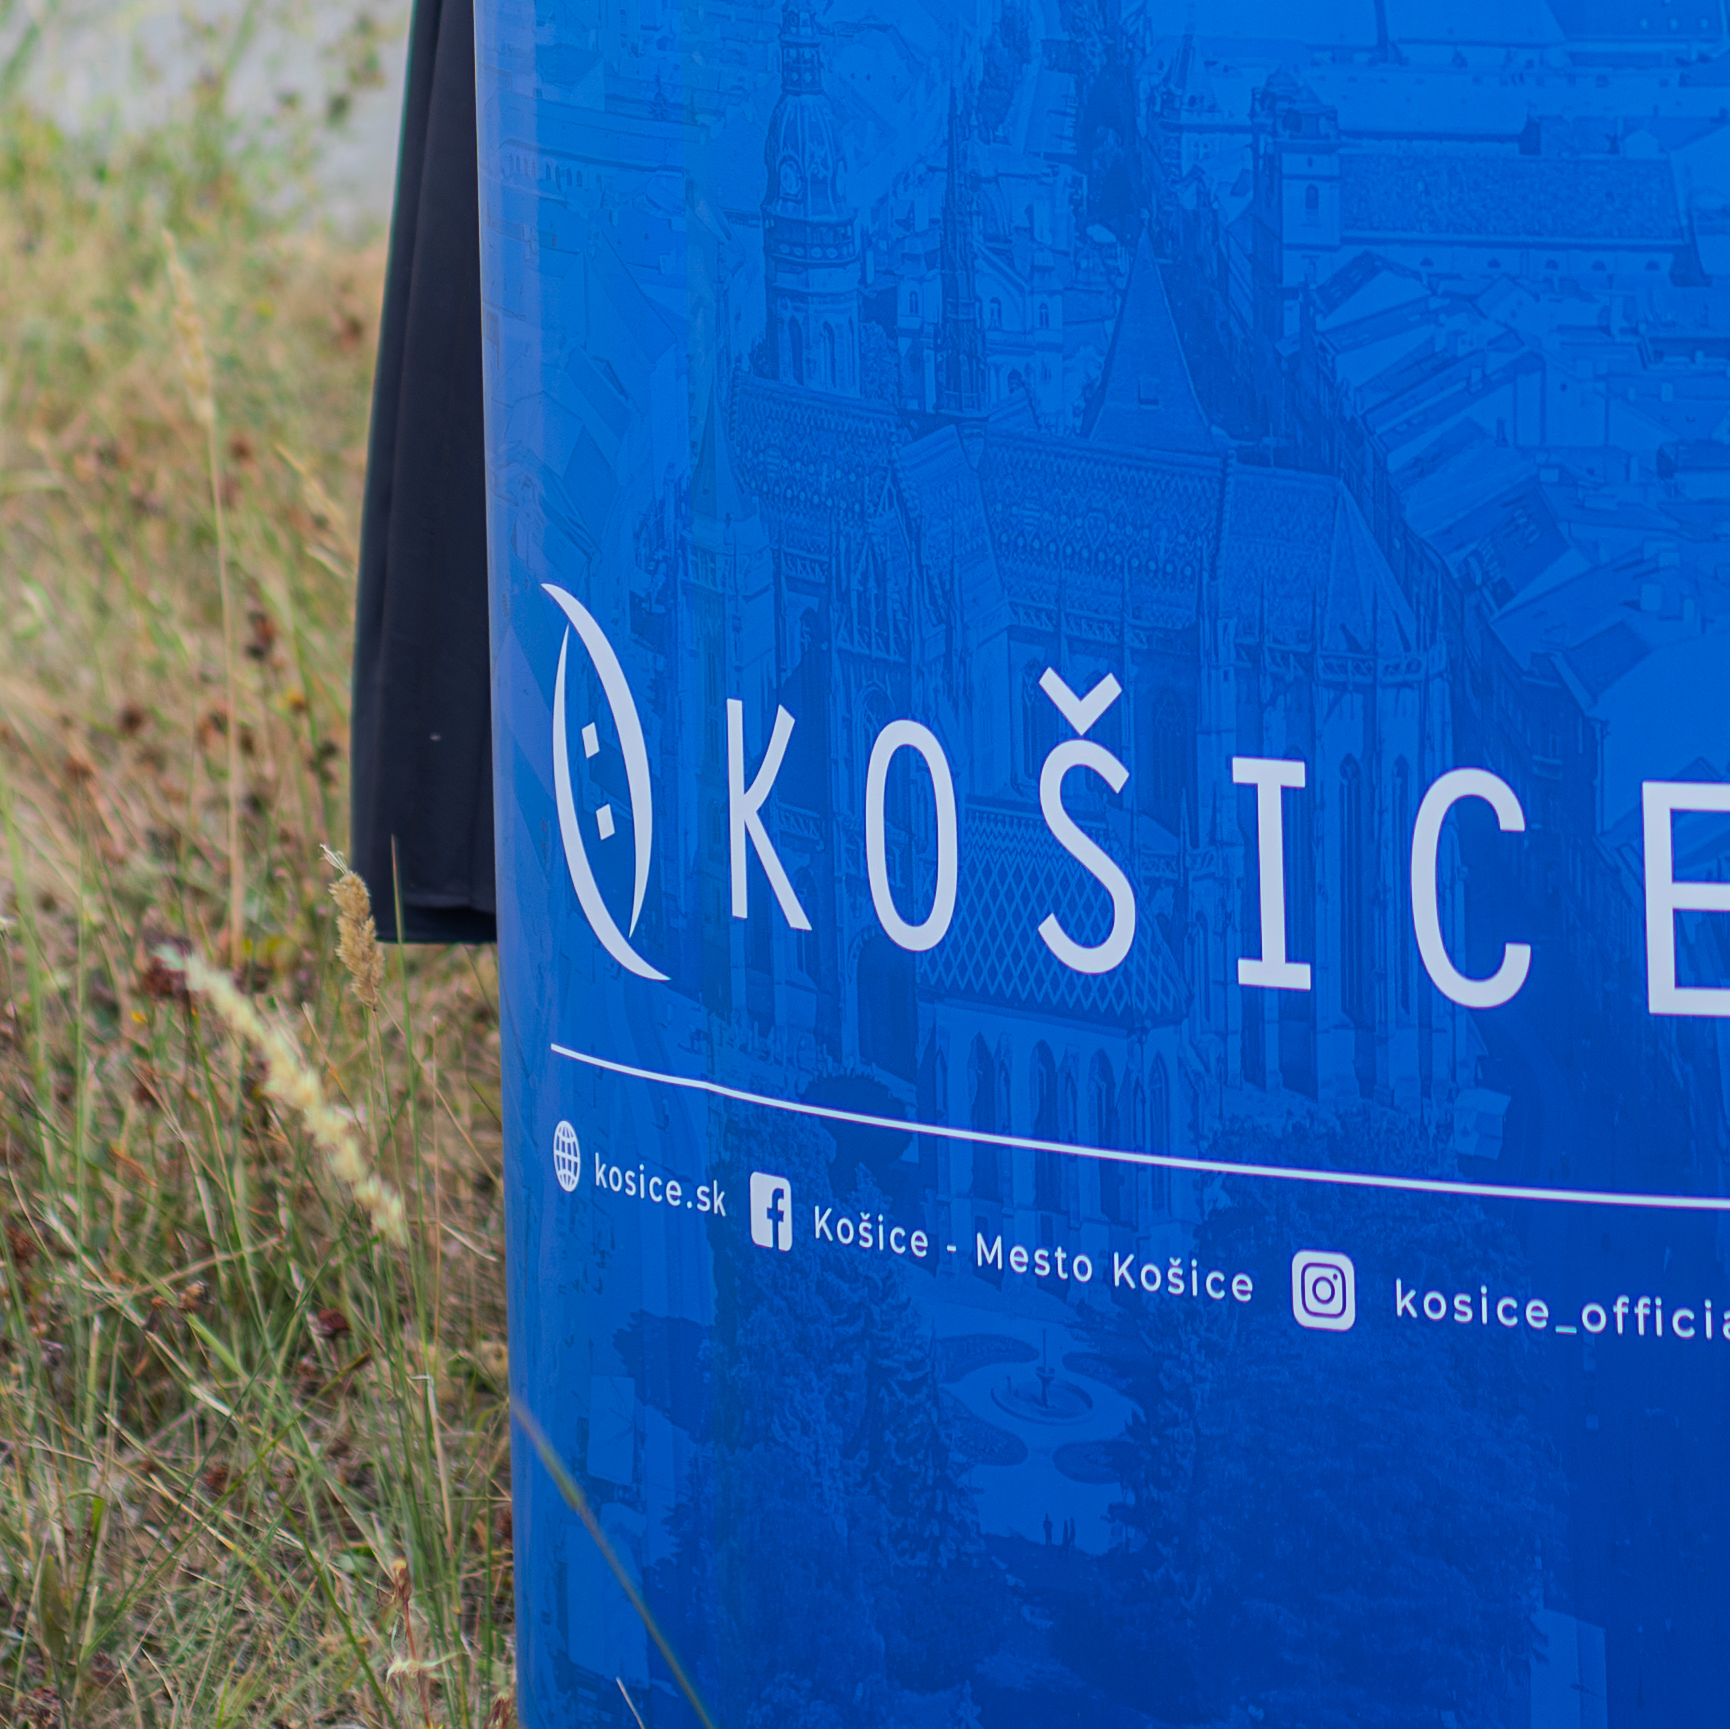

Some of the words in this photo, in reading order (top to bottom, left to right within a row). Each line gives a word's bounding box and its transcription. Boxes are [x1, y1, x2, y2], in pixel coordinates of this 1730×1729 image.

[595, 1152, 726, 1218] kosice.sk
[813, 1205, 929, 1258] Košice
[975, 1232, 1093, 1283] Mesto
[1112, 1251, 1254, 1302] Košice
